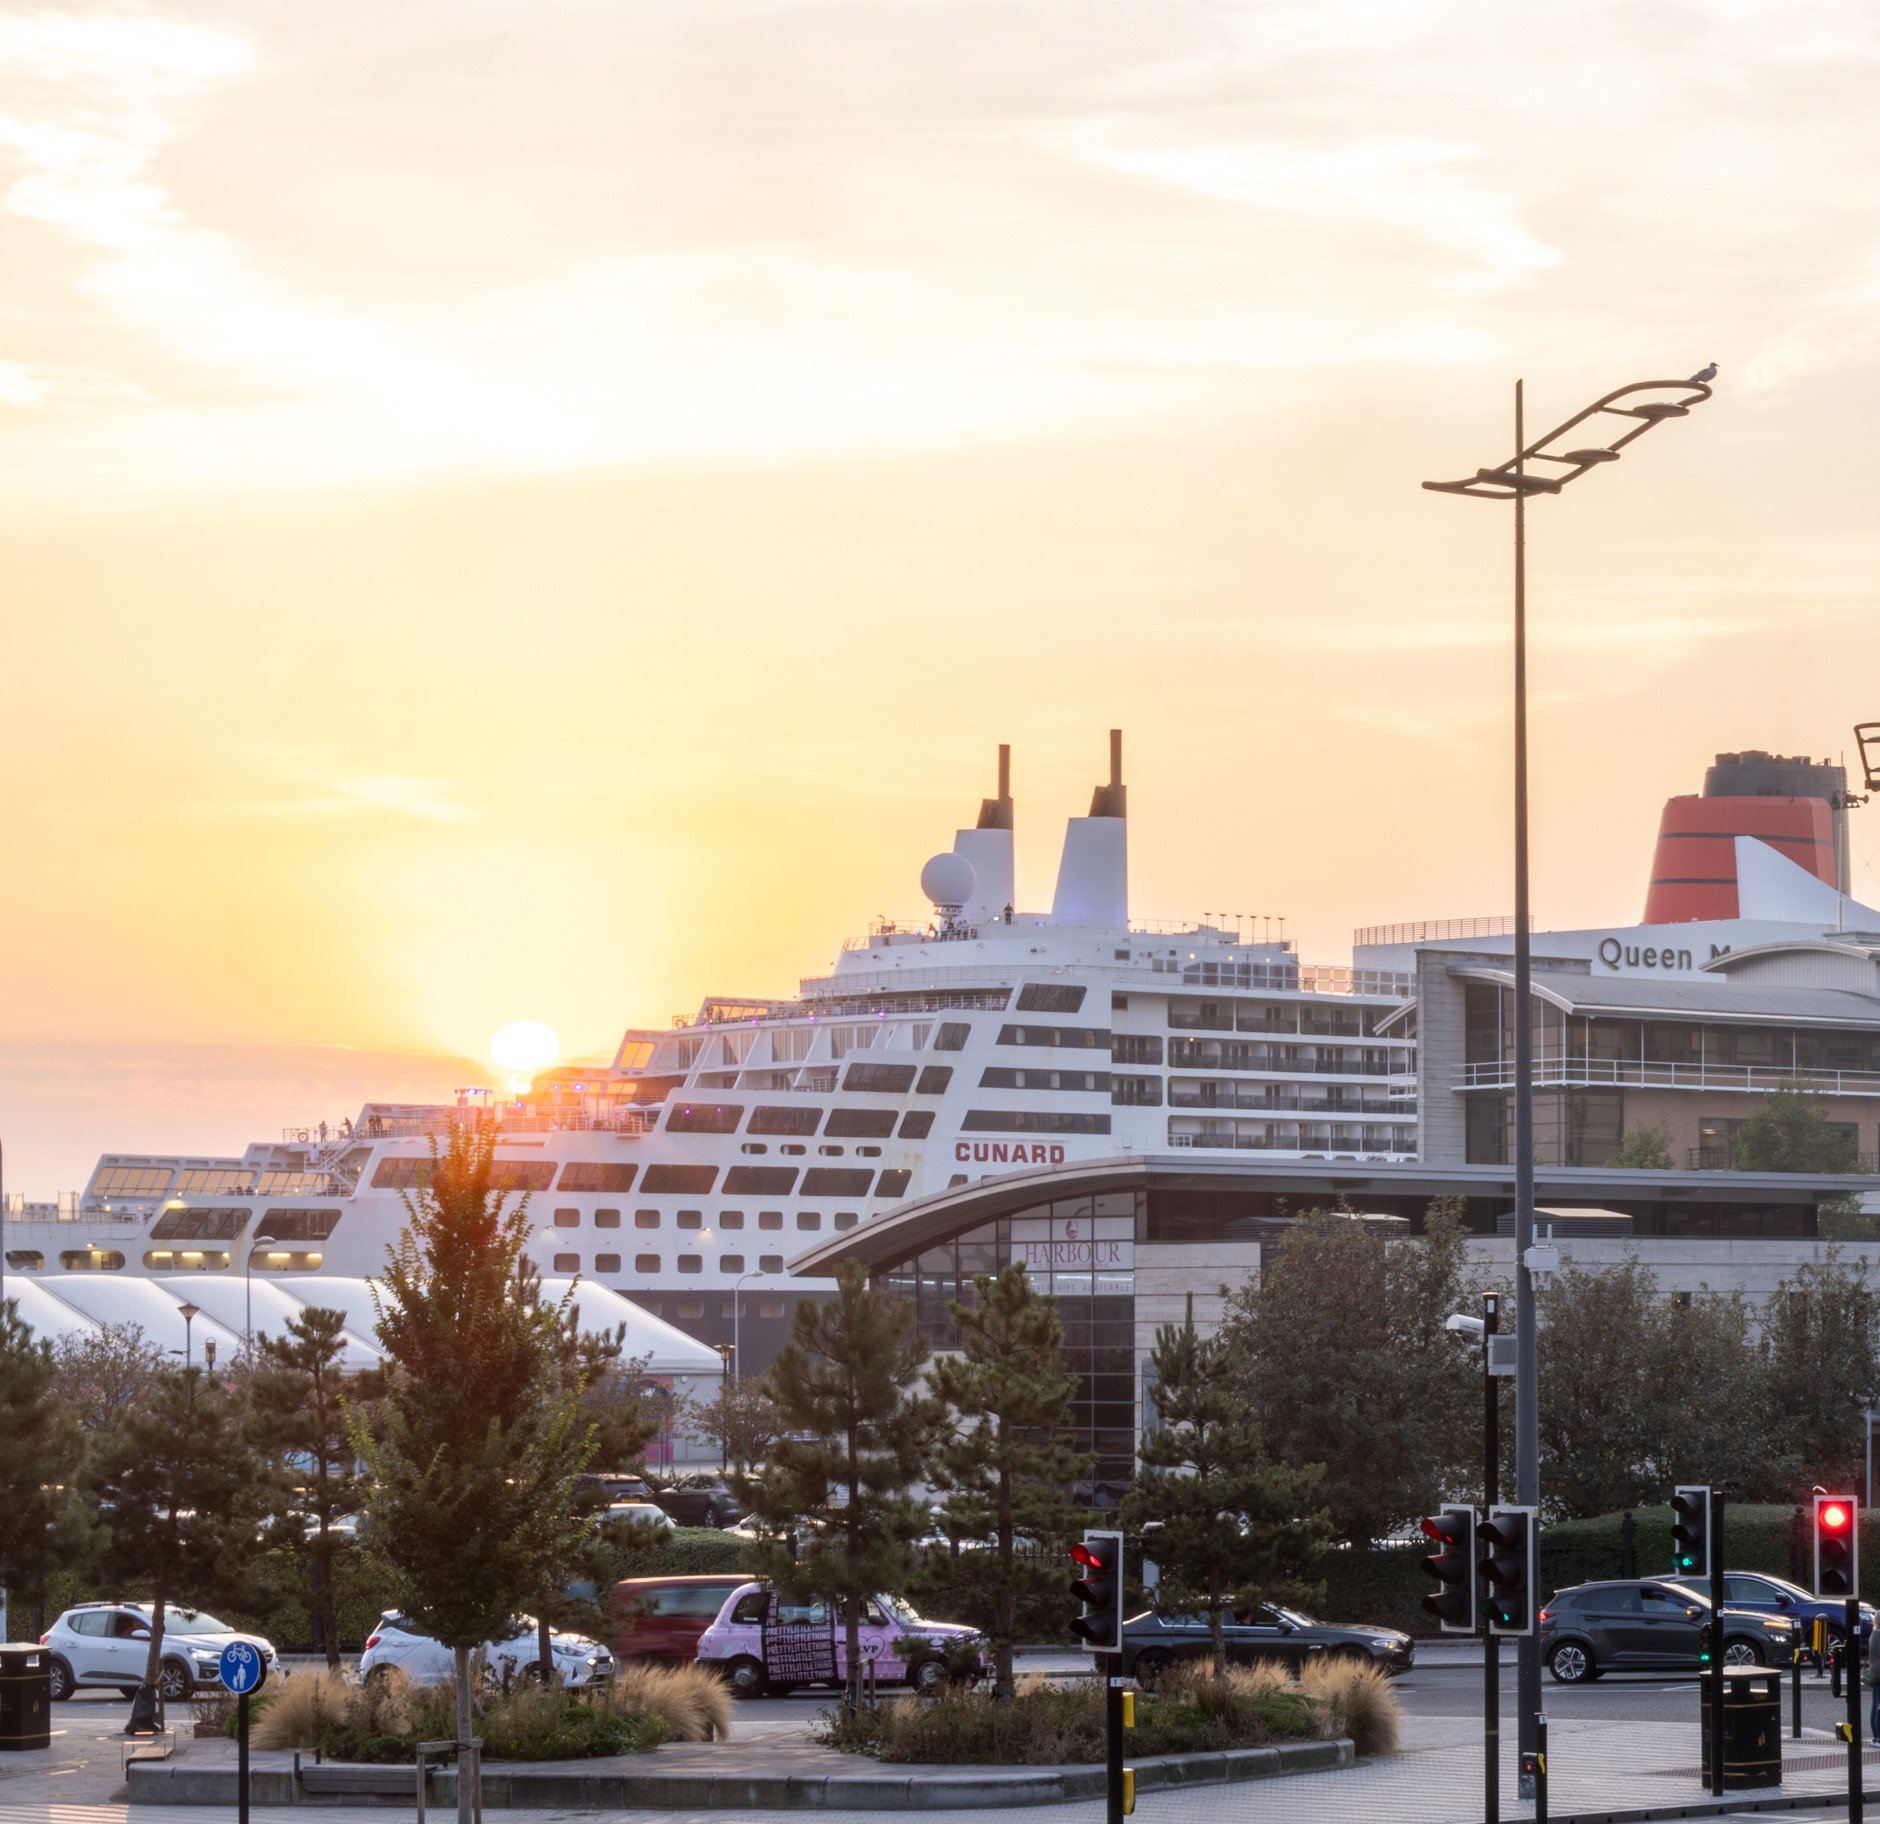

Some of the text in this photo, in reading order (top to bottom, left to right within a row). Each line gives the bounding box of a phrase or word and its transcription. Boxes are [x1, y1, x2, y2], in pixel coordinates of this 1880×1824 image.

[1599, 937, 1692, 971] Queen
[955, 1142, 1065, 1164] CUNARD
[1025, 1242, 1121, 1264] HARBOUR
[1082, 1283, 1130, 1292] AVAILABLE
[766, 1631, 831, 1645] PRETTYLITTLETHING
[767, 1641, 831, 1655] PRETTYLITTLETHING
[768, 1650, 832, 1664] PRETTYLITTLETHING
[769, 1660, 833, 1674] PRETTYLITTLETHING
